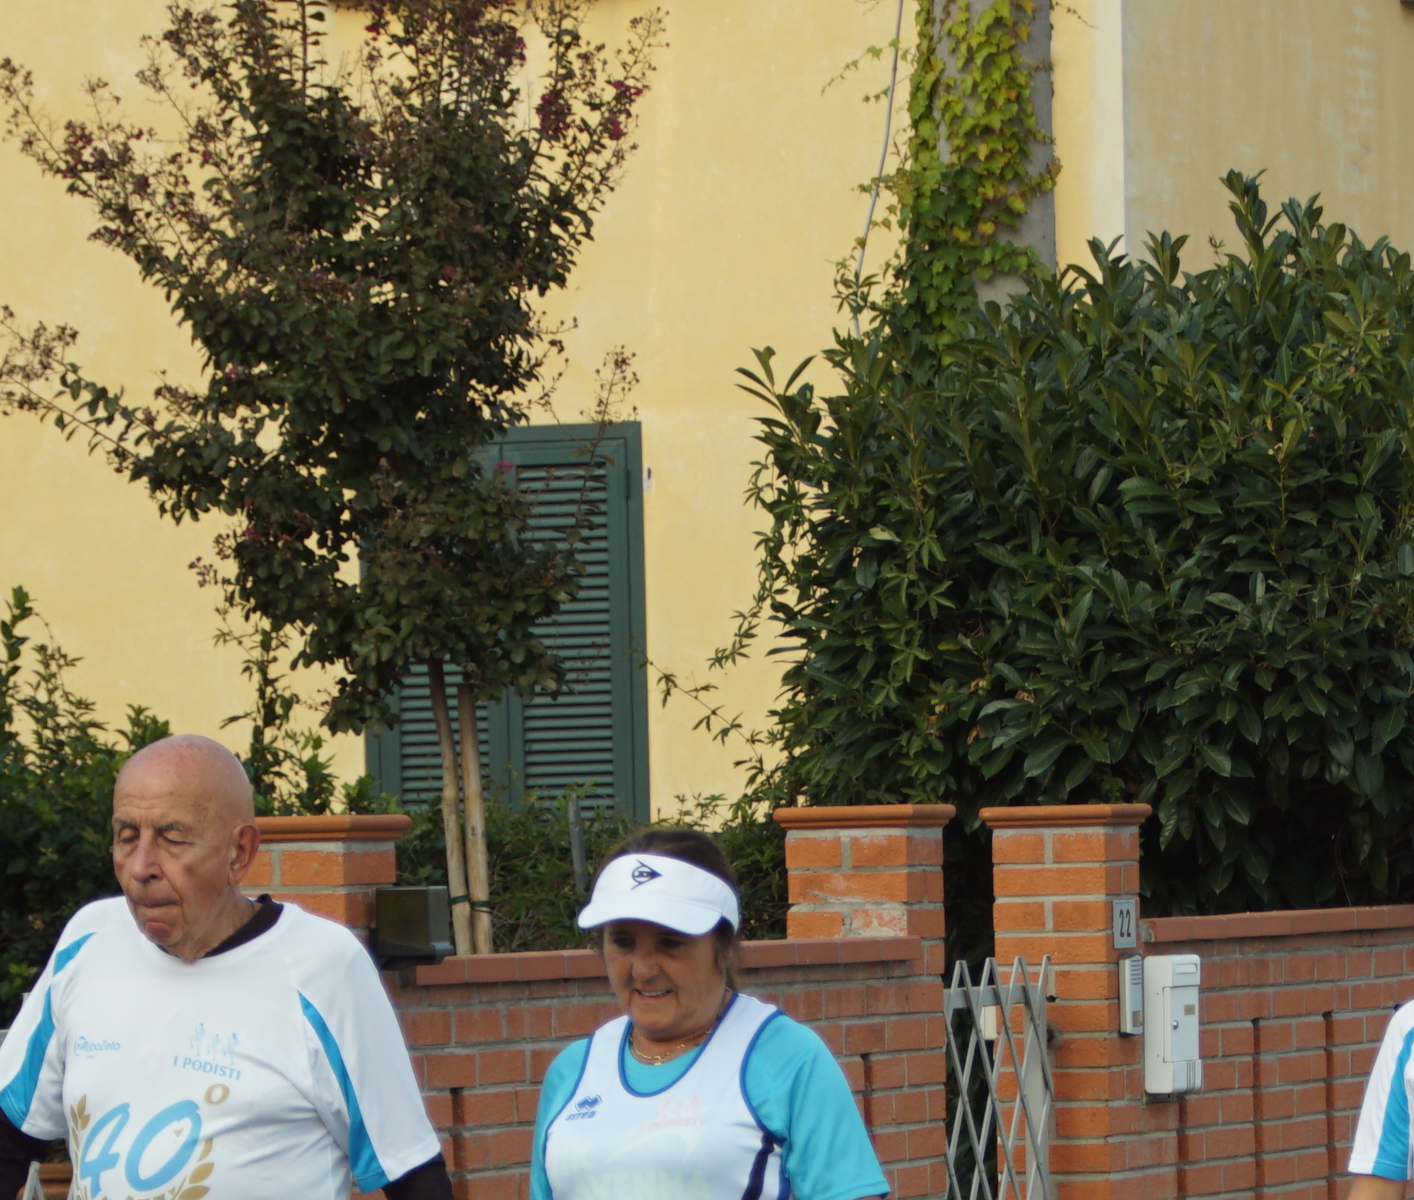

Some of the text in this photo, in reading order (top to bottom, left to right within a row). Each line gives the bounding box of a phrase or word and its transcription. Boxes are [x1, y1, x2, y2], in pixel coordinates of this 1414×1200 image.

[1118, 908, 1132, 938] 22
[172, 1055, 242, 1081] I PODISTI
